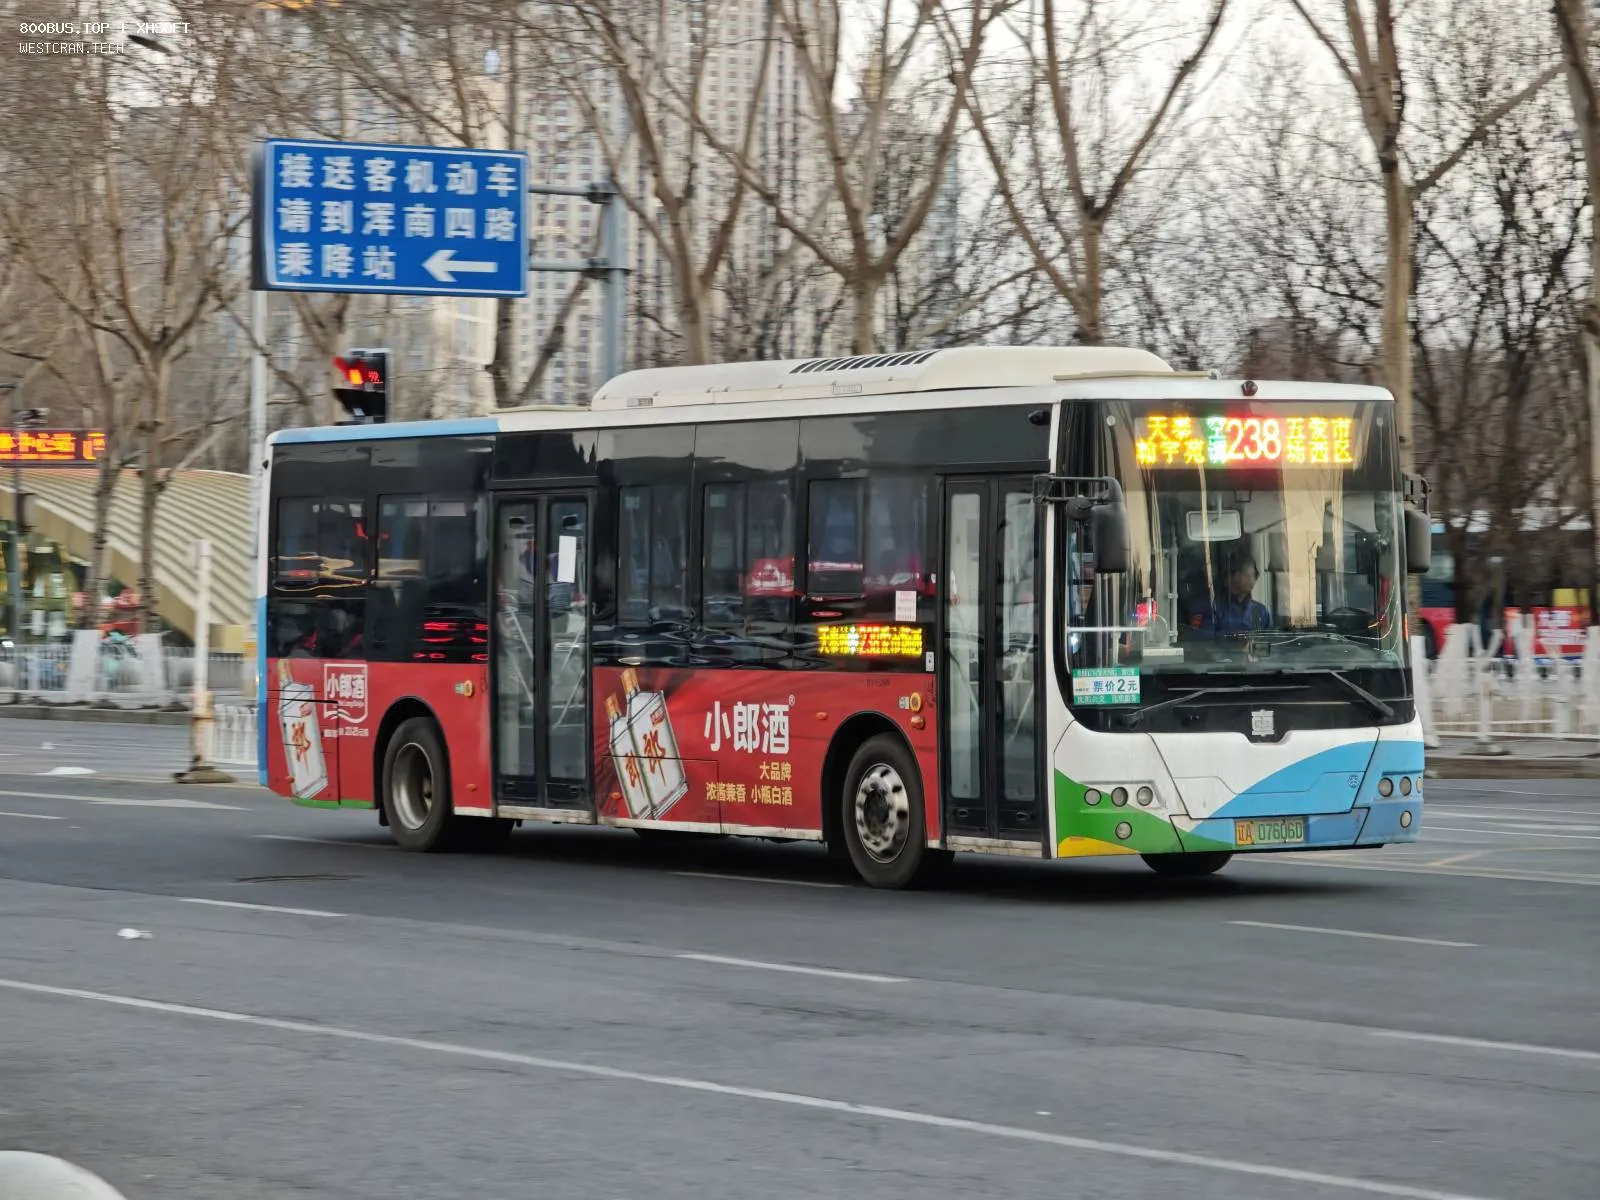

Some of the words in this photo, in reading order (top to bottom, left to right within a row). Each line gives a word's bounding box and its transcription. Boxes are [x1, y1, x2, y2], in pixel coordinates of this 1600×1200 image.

[279, 153, 518, 197] 接送客机动车
[277, 198, 518, 241] 请到浑南四路
[278, 242, 397, 280] 乘降站
[1226, 418, 1282, 460] 238
[1093, 678, 1137, 692] 票价2元
[703, 700, 790, 754] 小郎酒
[759, 760, 792, 781] 大品牌
[706, 782, 746, 802] 浓酱兼香
[751, 784, 793, 806] 小瓶白酒
